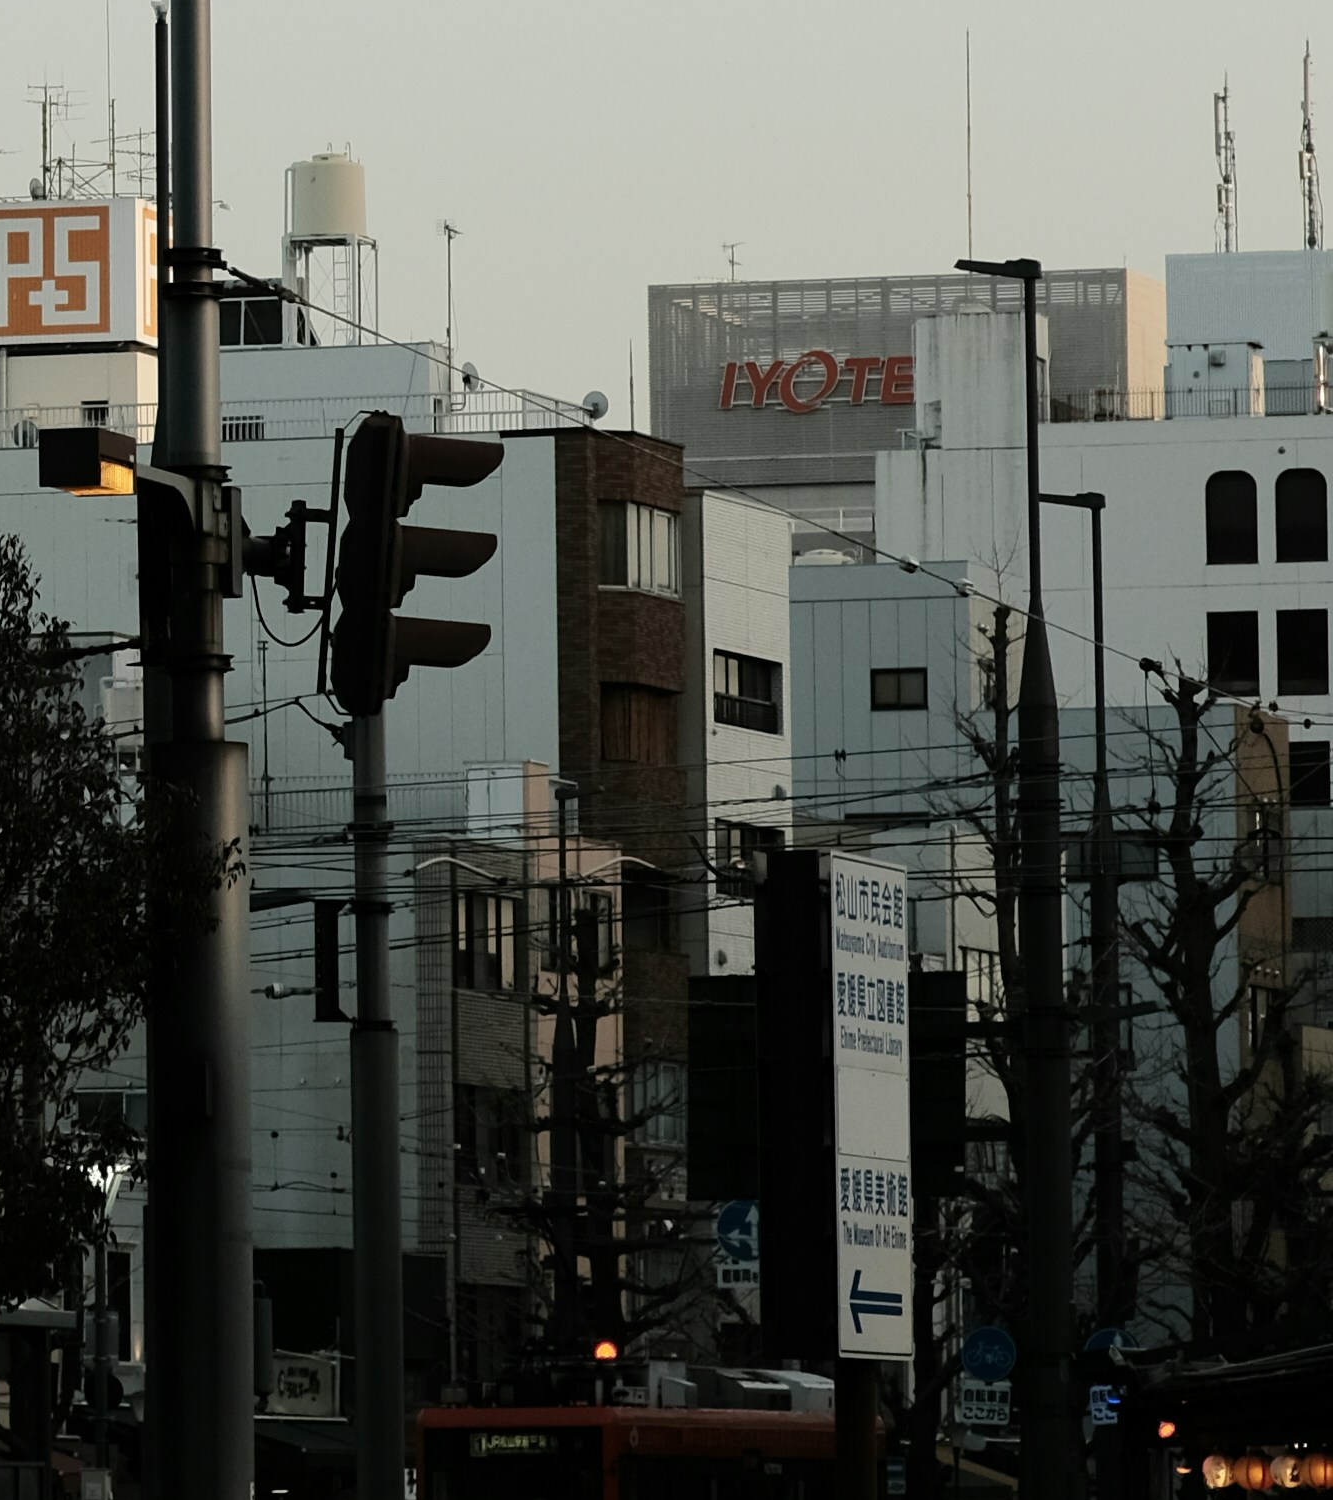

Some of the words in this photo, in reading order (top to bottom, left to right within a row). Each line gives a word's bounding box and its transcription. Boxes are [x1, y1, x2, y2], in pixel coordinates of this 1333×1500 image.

[719, 349, 917, 414] IYOTE
[835, 872, 904, 930] 松山市民会館
[840, 1168, 908, 1217] 愛媛県美術館
[963, 1406, 1008, 1422] ここから
